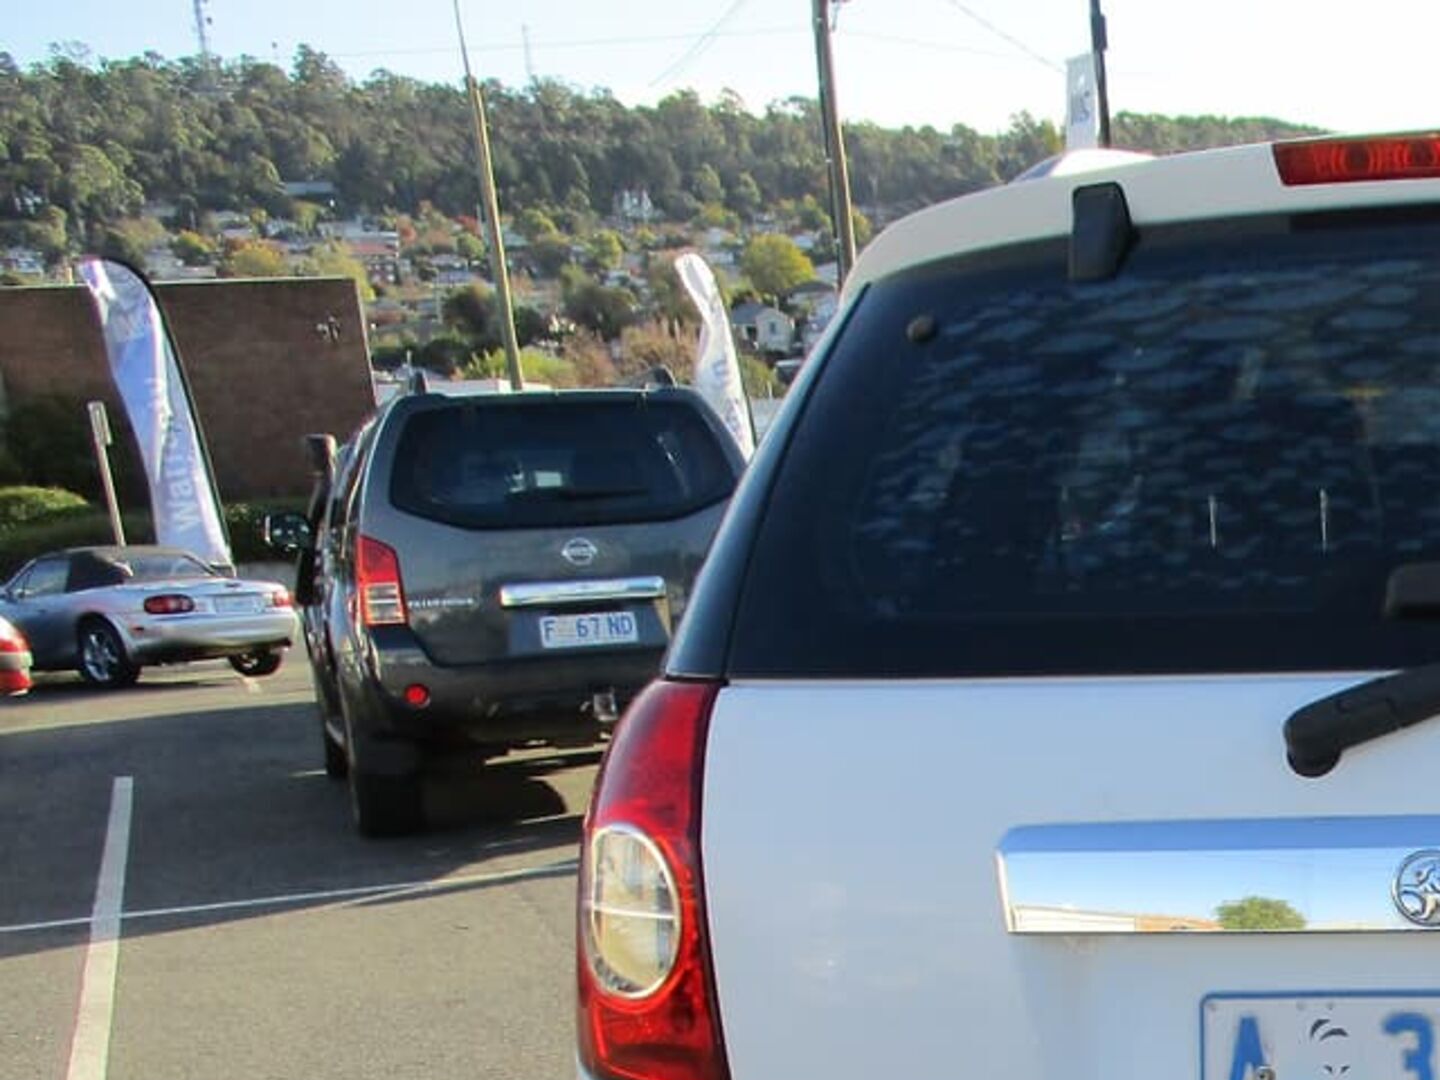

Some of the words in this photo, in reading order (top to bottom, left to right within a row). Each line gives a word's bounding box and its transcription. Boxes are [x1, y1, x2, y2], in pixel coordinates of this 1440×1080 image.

[543, 619, 555, 642] F
[576, 617, 600, 638] 67
[607, 614, 633, 635] ND
